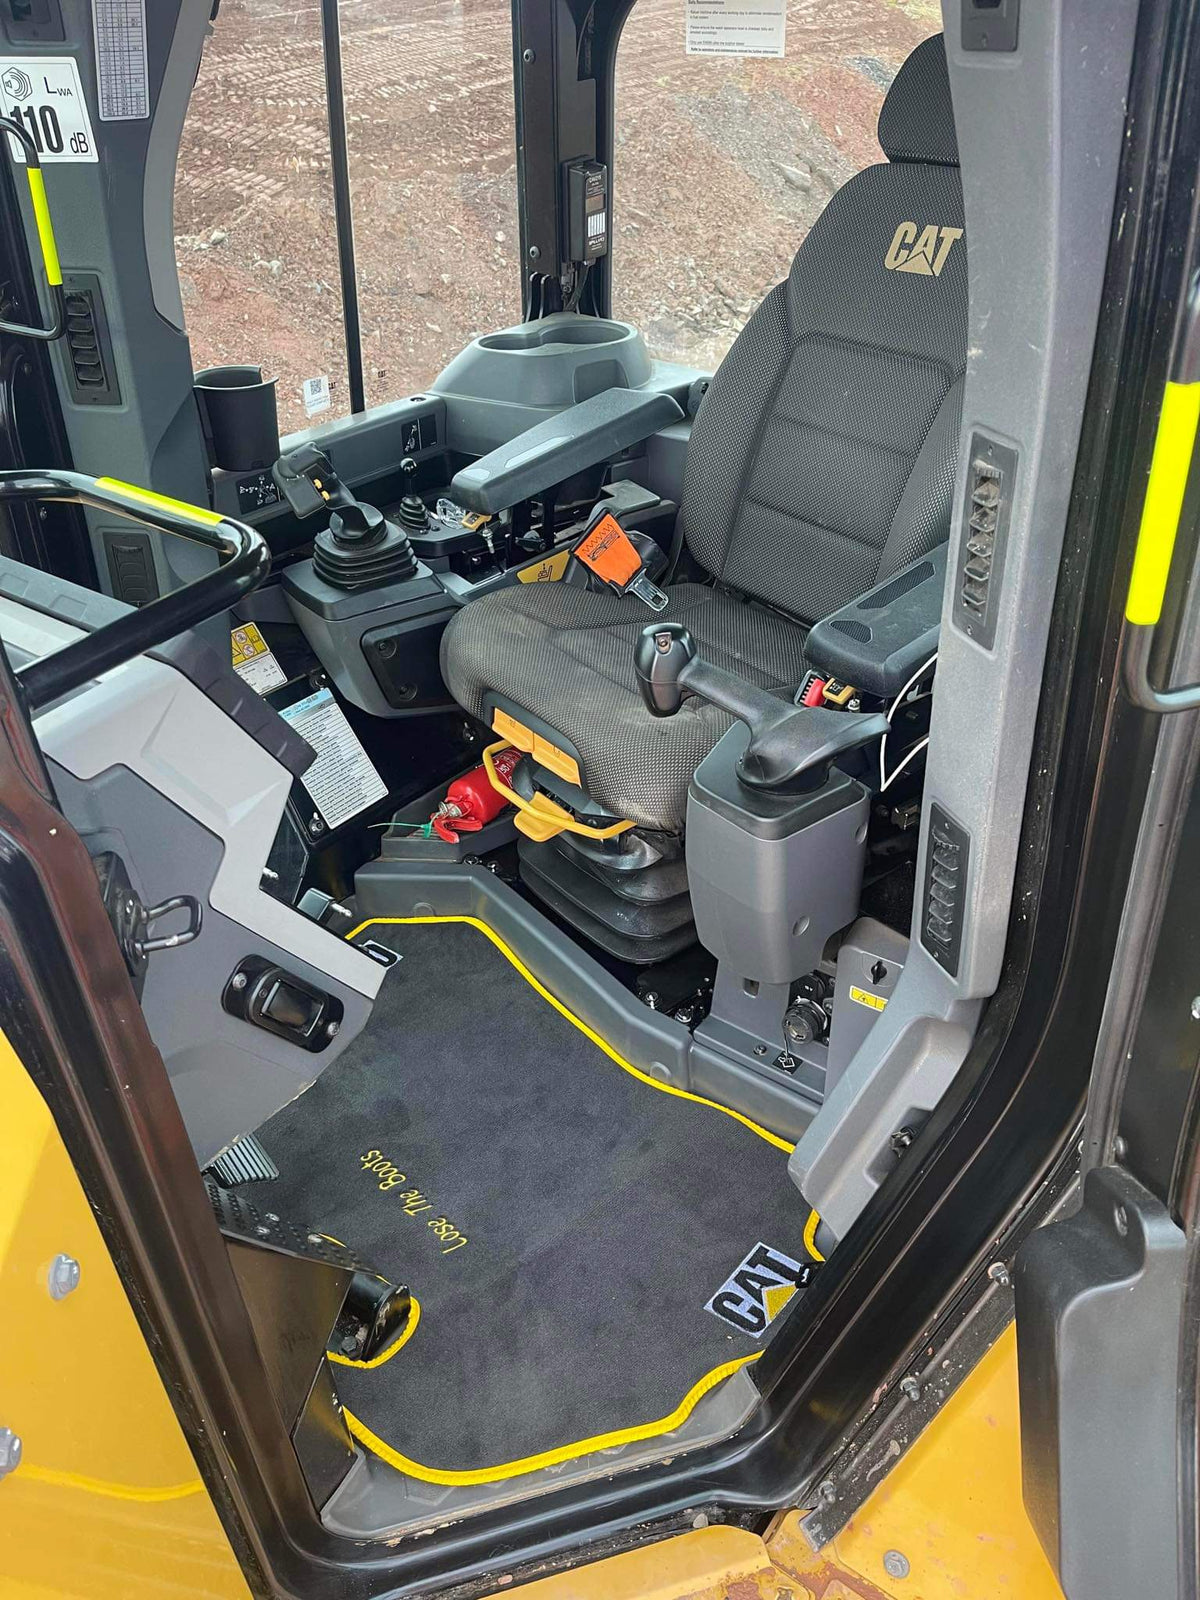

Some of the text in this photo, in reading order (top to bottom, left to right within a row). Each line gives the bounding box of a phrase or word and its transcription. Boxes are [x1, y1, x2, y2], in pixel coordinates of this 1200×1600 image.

[69, 132, 89, 154] dB
[885, 221, 964, 277] CAT
[360, 1150, 468, 1254] Lose The Boots
[712, 1246, 803, 1333] CAT
